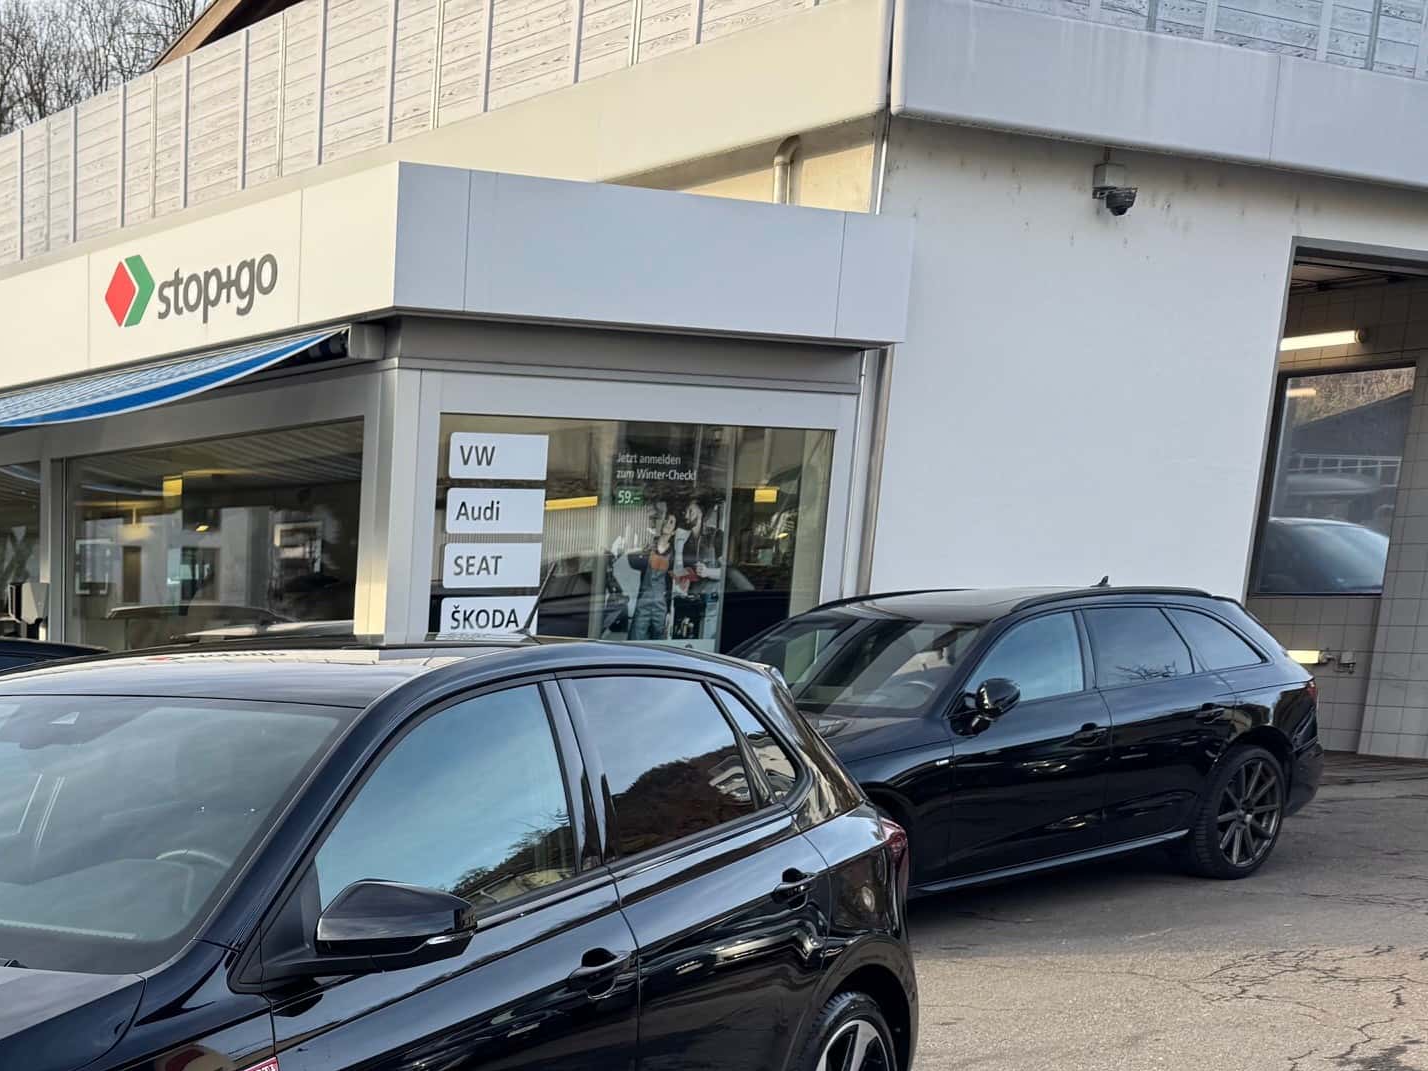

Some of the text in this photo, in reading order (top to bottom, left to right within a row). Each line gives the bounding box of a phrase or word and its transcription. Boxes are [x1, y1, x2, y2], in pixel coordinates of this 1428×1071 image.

[157, 253, 278, 324] stop+go
[459, 445, 496, 467] VW
[618, 453, 681, 466] Jetzt anmelden
[616, 469, 634, 479] zum
[455, 499, 501, 522] Audi
[453, 554, 503, 577] SEAT
[451, 604, 520, 630] ŠKODA
